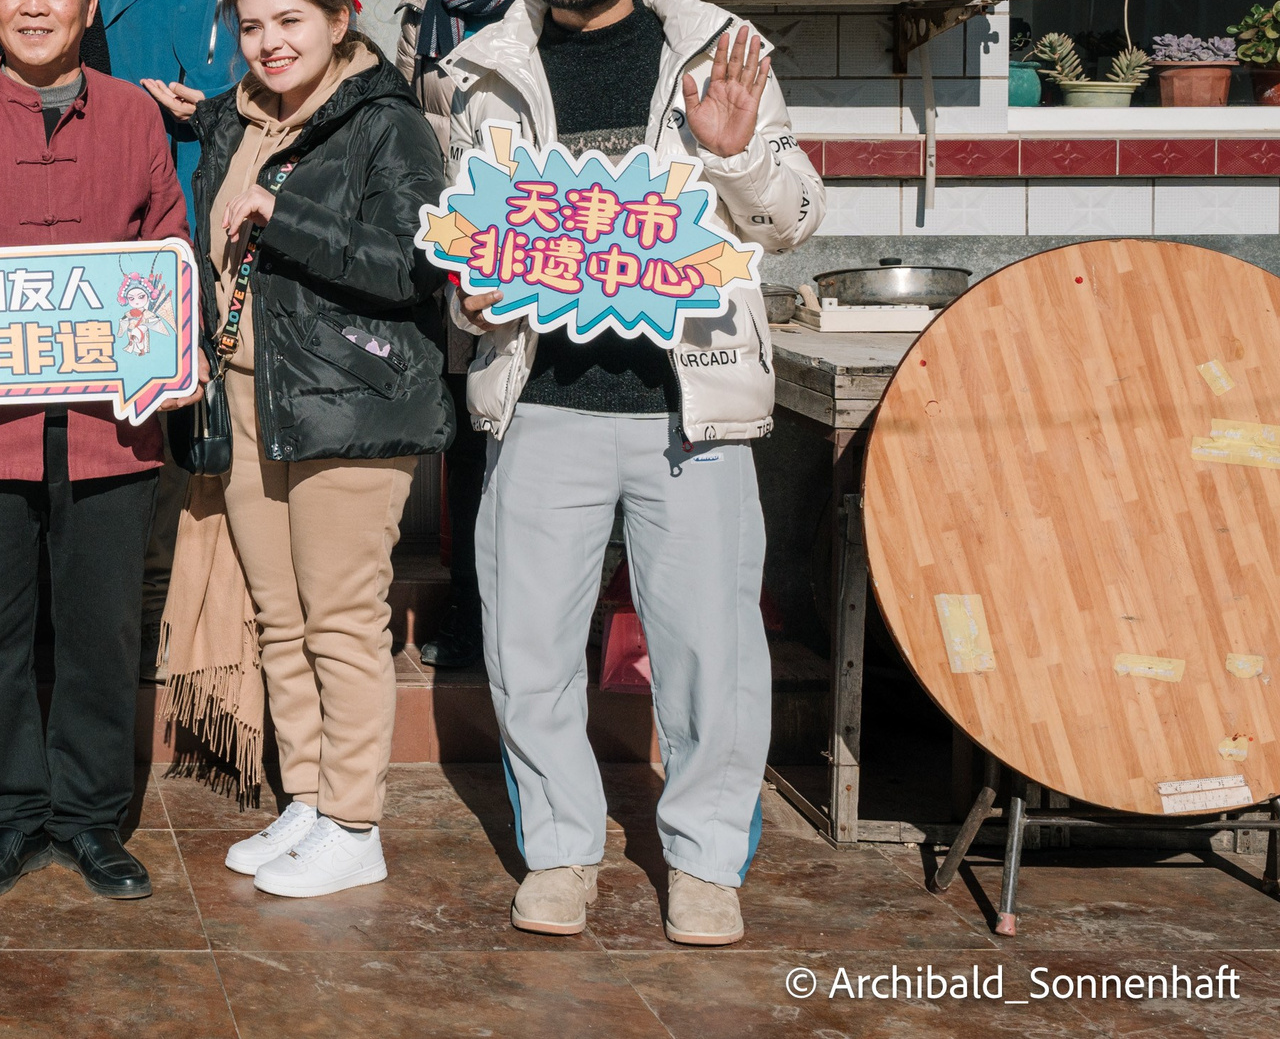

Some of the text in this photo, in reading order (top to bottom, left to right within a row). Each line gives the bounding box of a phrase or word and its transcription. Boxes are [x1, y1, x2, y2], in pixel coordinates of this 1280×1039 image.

[270, 155, 300, 191] LOVE
[507, 181, 682, 249] 天津市
[237, 243, 256, 285] LOVE
[468, 225, 705, 298] 非遗中心
[225, 289, 245, 332] LOVE
